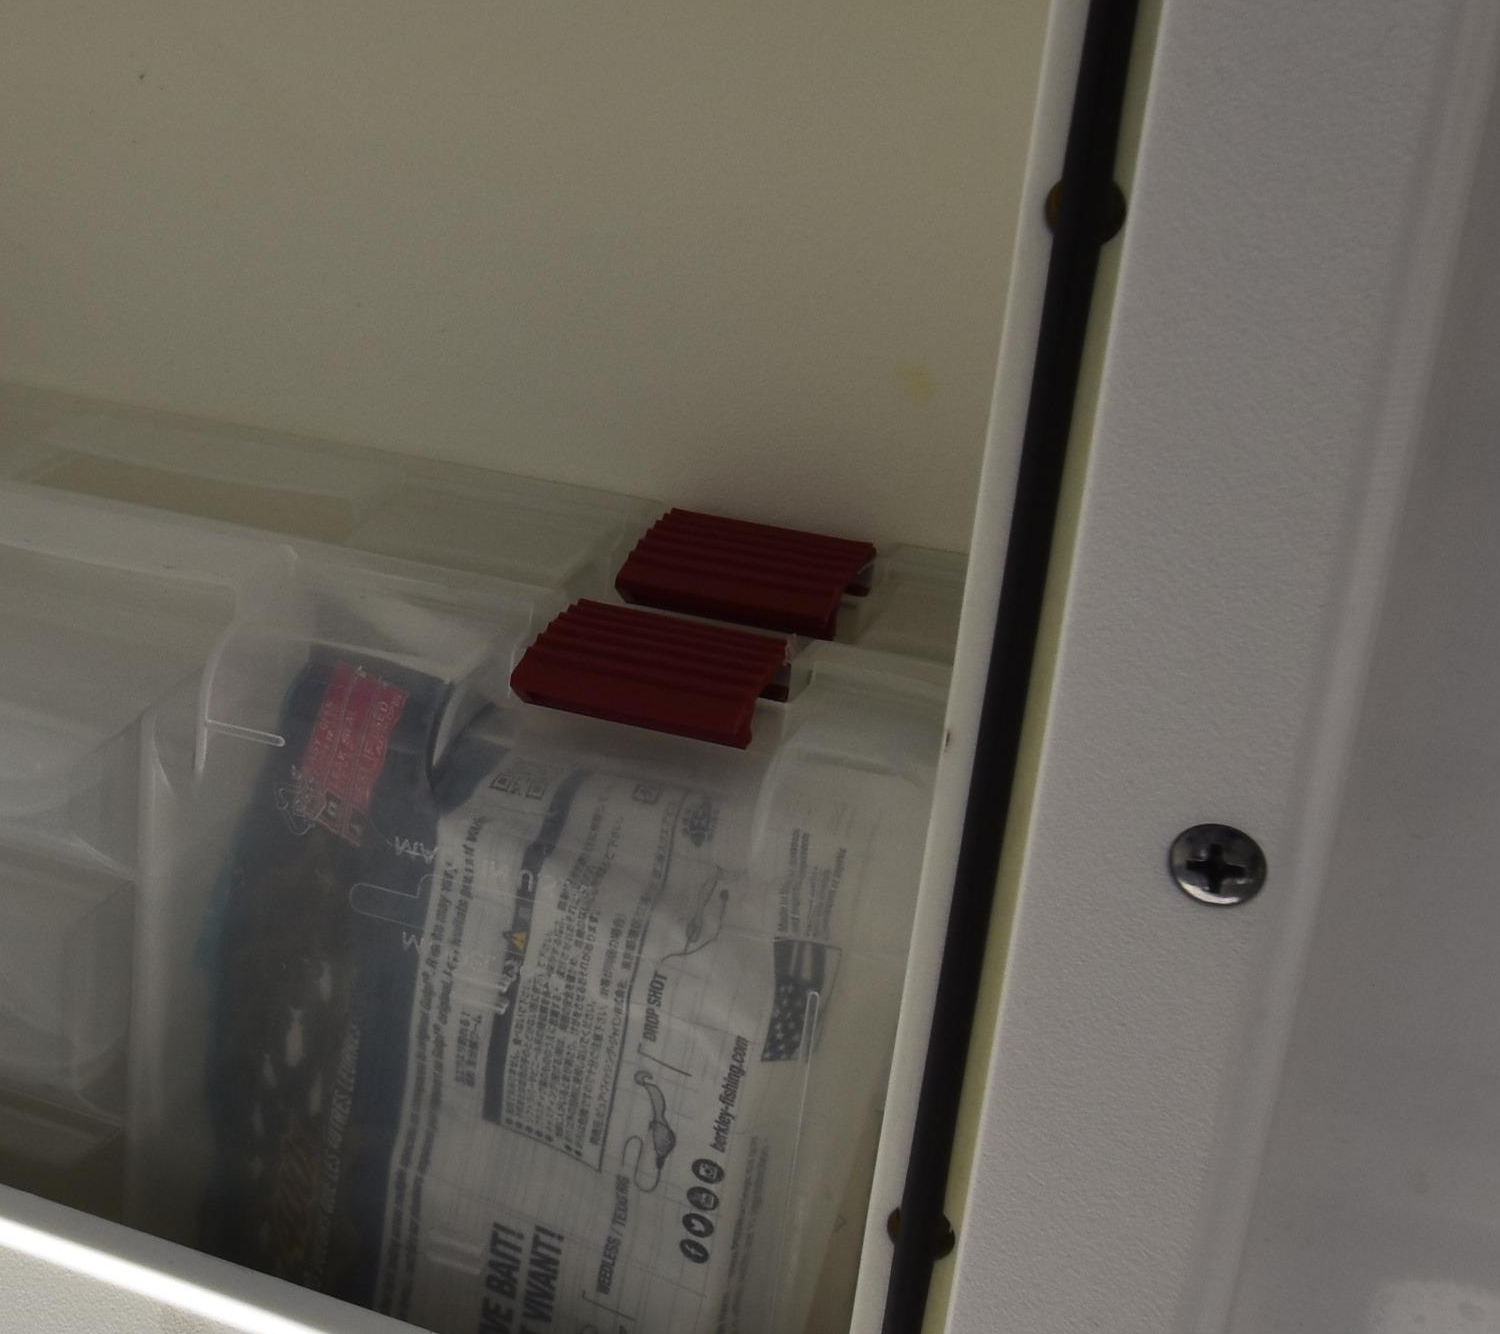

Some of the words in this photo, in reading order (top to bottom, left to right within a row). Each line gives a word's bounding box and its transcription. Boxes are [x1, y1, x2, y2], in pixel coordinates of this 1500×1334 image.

[647, 971, 667, 1007] SHOT
[643, 1008, 659, 1042] DROP
[710, 1036, 748, 1152] berkley-fishing.com
[485, 1223, 524, 1299] BAIT!
[523, 1226, 564, 1322] VIVANT!
[597, 1237, 620, 1294] WEEDLESS
